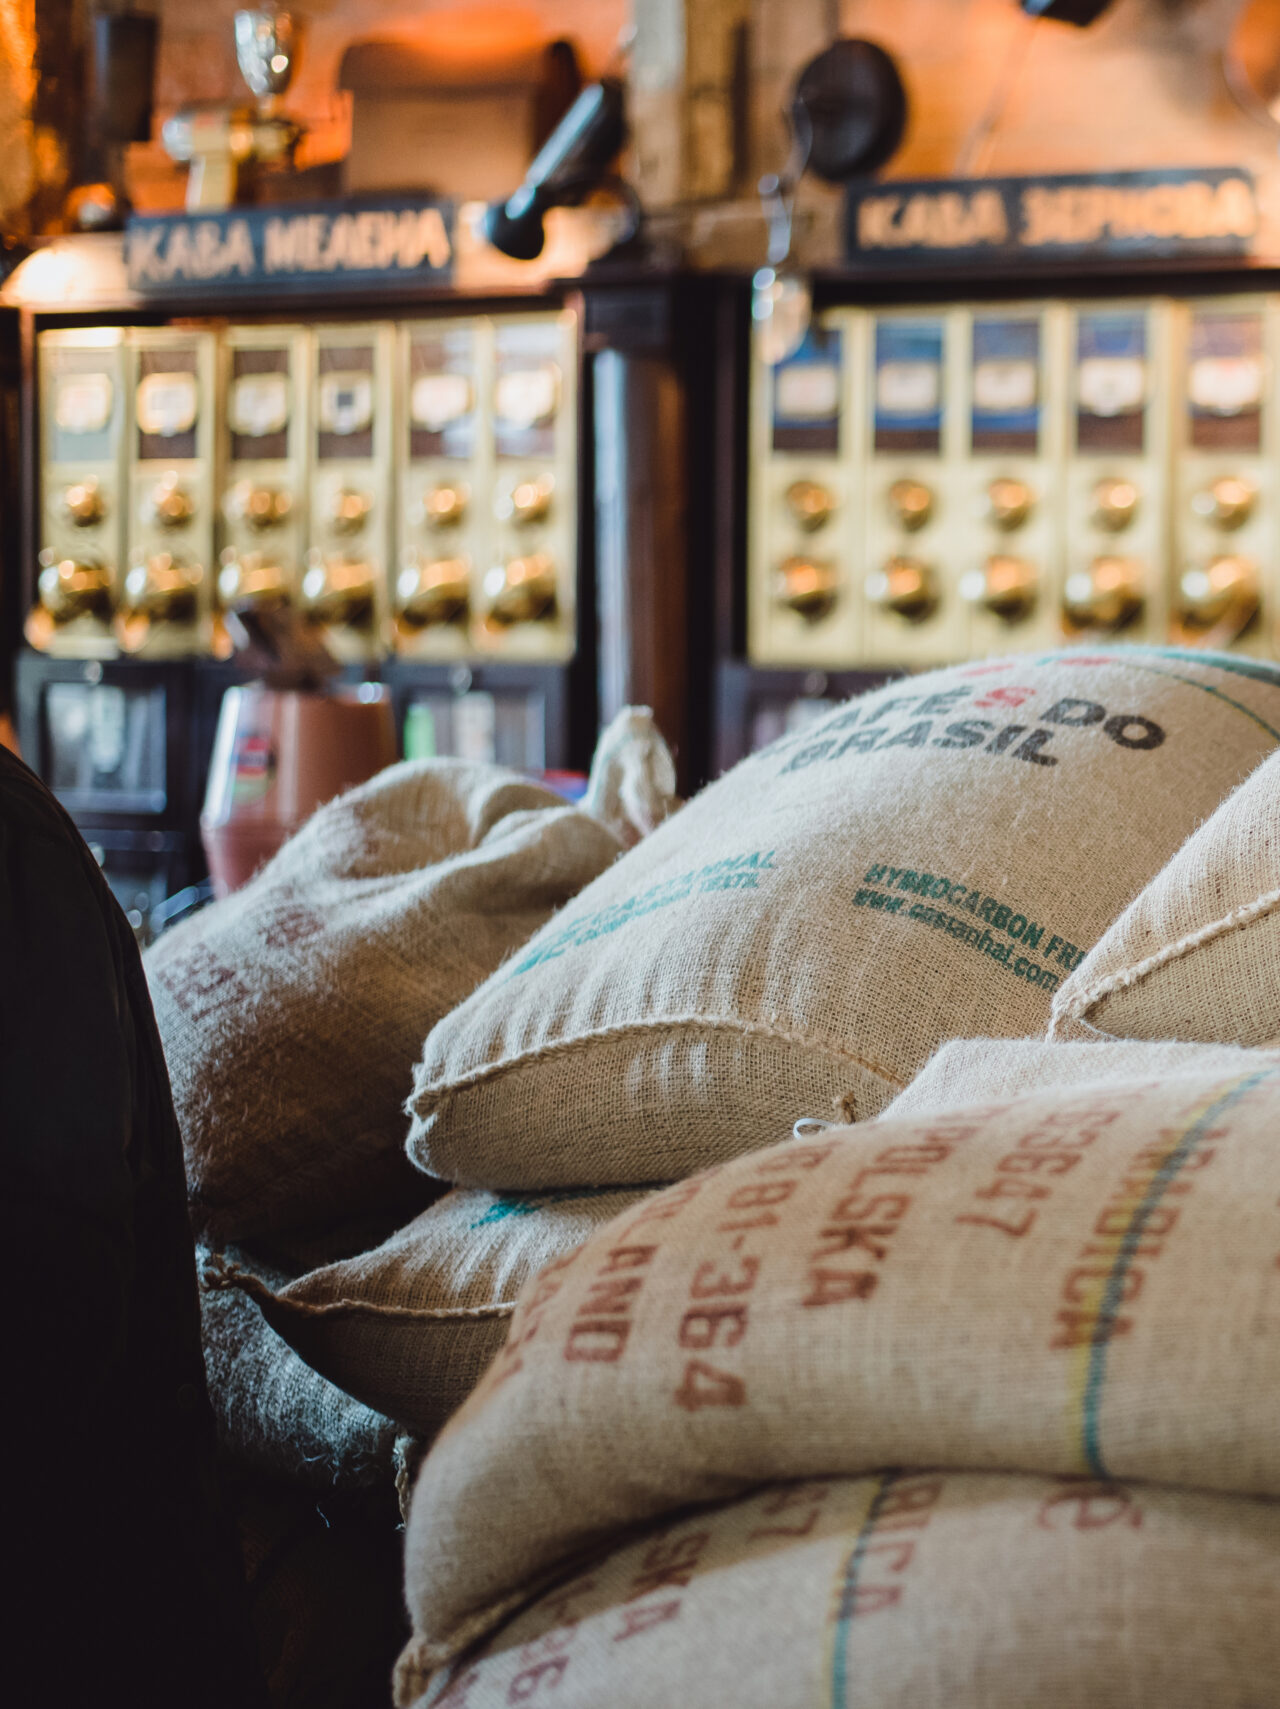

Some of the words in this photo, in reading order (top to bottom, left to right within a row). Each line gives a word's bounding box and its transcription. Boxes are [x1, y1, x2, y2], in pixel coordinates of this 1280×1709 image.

[129, 214, 255, 284] КАВА
[778, 718, 1059, 769] BRASIL
[1038, 697, 1168, 752] DO
[863, 862, 1046, 951] HYDROCARBON
[800, 1124, 982, 1308] POLSKA
[1049, 1126, 1233, 1350] ARABICA
[673, 1178, 800, 1413] 81-364
